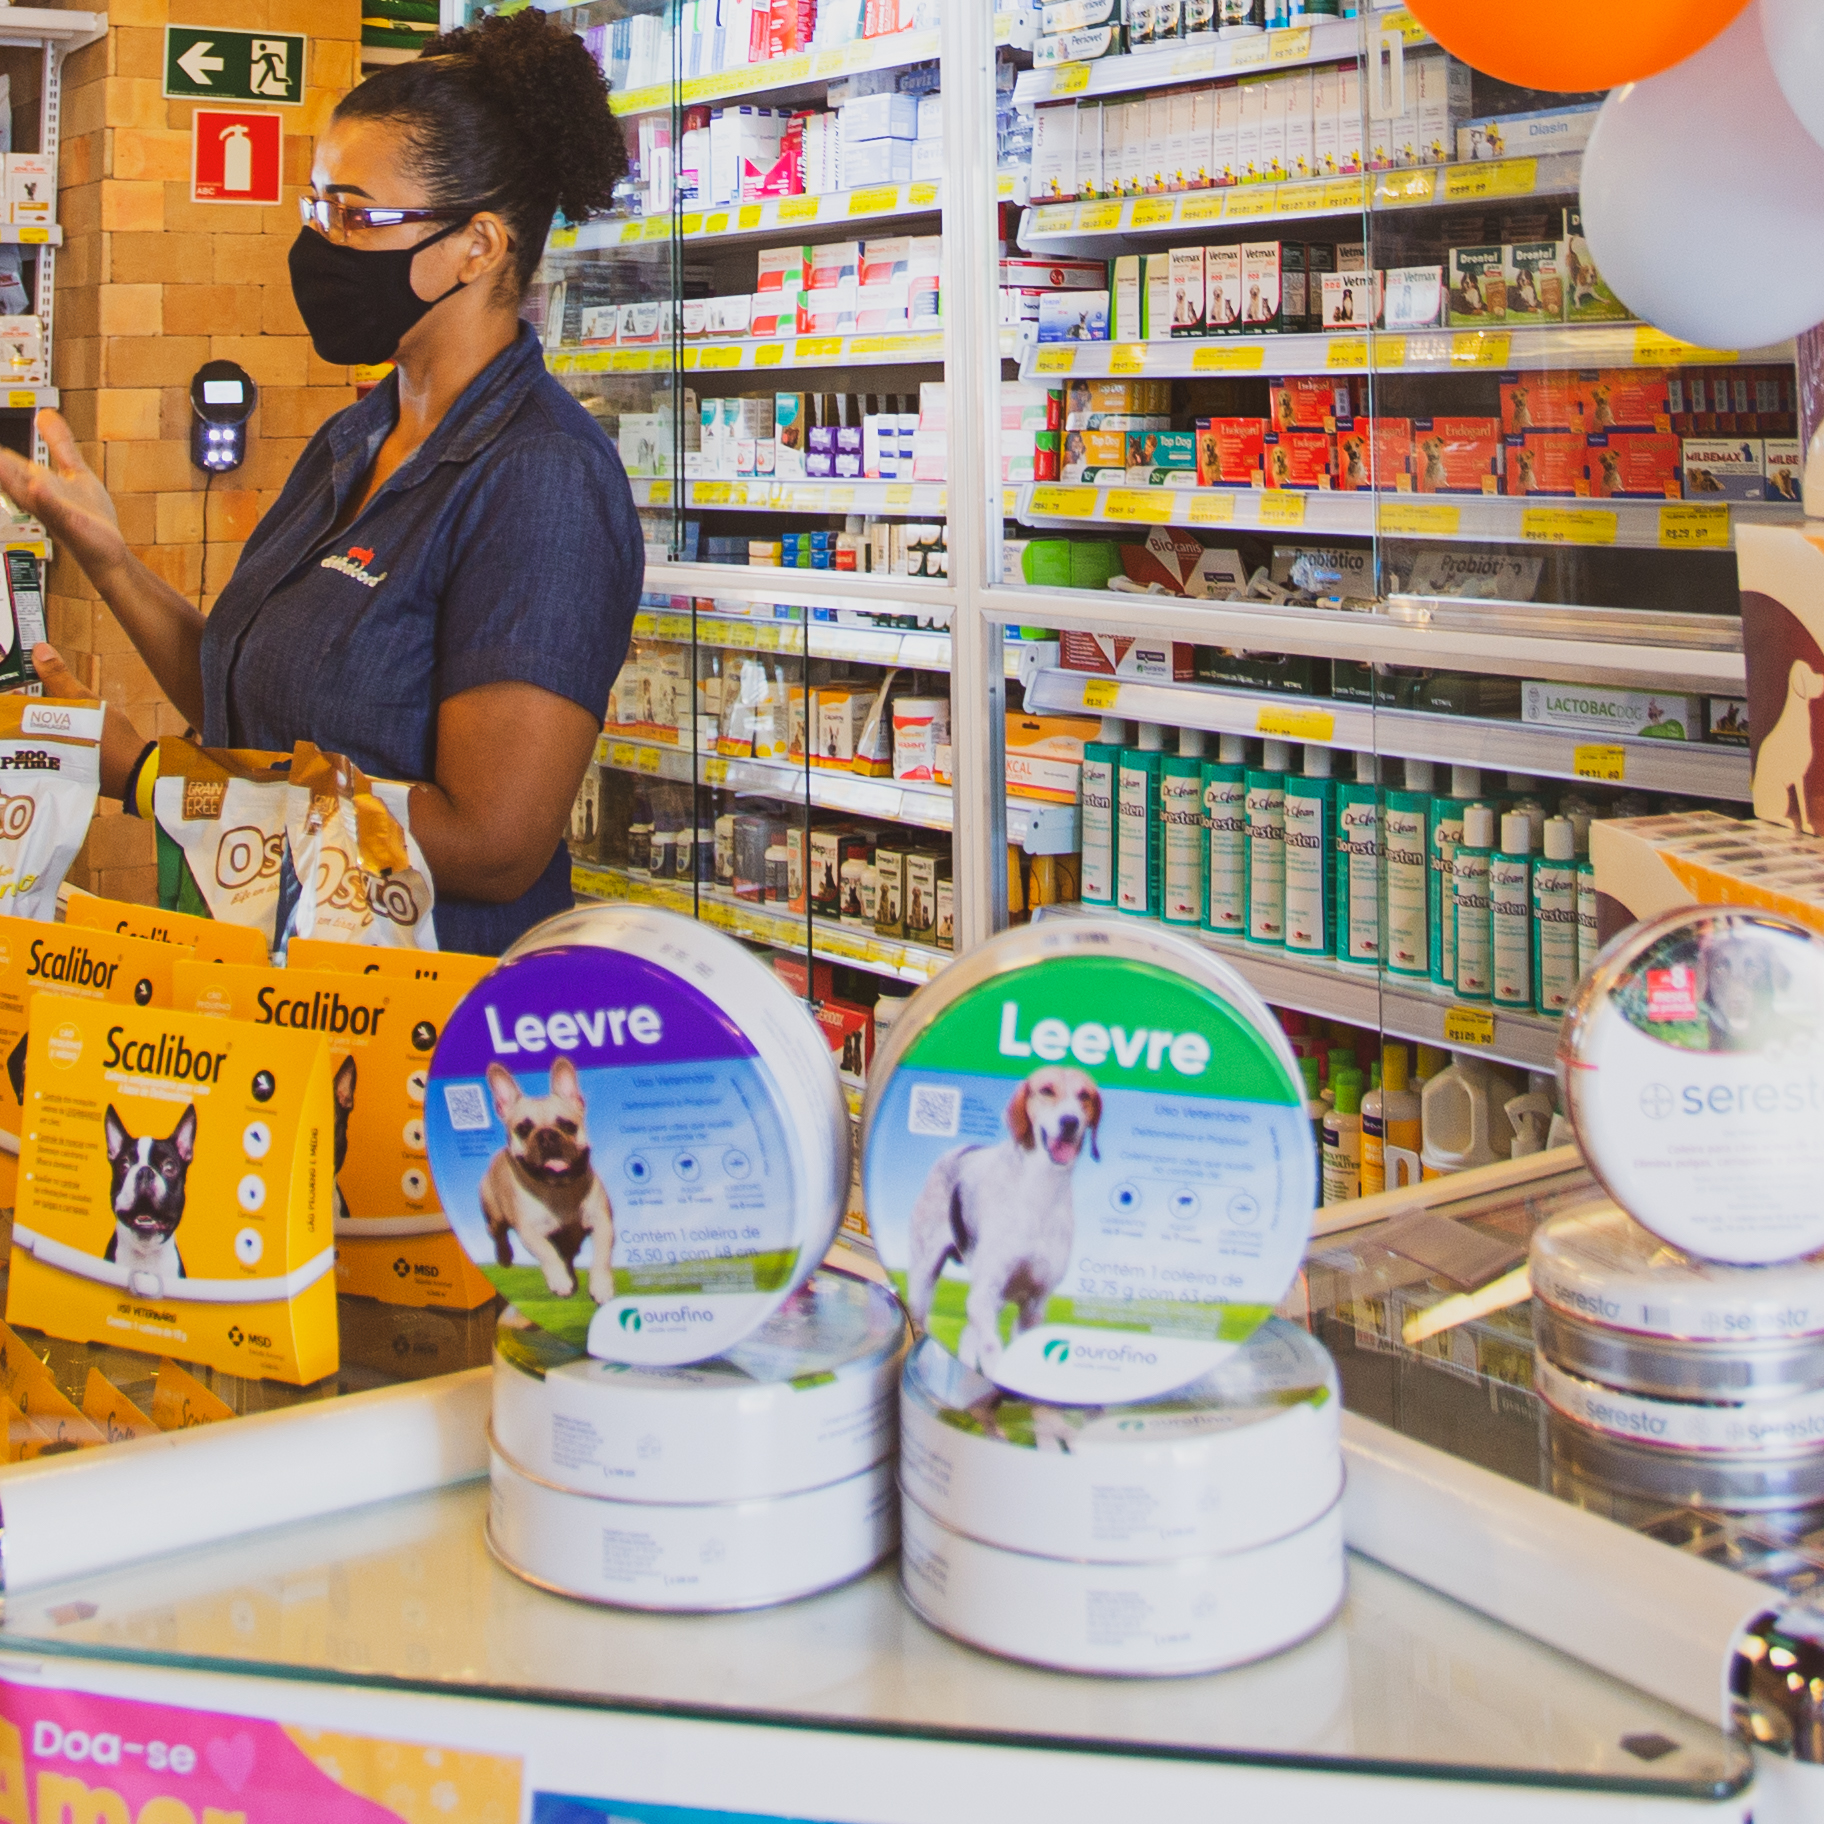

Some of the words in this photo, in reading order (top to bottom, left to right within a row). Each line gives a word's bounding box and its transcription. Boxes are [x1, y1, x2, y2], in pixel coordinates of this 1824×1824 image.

[1529, 121, 1568, 137] Diasin
[196, 187, 215, 195] ABC
[1172, 252, 1201, 263] Vetmax
[1208, 250, 1238, 261] Vetmax
[1245, 248, 1276, 259] Vetmax
[1459, 252, 1499, 264] Drontal
[1515, 248, 1553, 262] Drontal
[1445, 422, 1497, 440] Endogard
[1091, 435, 1105, 448] Top
[1106, 436, 1120, 449] Dog
[1160, 435, 1174, 449] Top
[1175, 436, 1192, 451] Dog
[1686, 450, 1742, 464] MILBEMAX
[1768, 453, 1799, 466] MILBE
[1151, 536, 1205, 556] Biocanis
[30, 711, 72, 726] NOVA
[185, 794, 219, 816] FREE
[26, 939, 119, 989] Scalibor
[255, 986, 385, 1036] Scalibor
[485, 1004, 664, 1054] Leevre
[998, 999, 1212, 1075] Leevre
[103, 1026, 227, 1083] Scalibor
[620, 1227, 676, 1244] Contém
[690, 1226, 738, 1243] coleira
[742, 1226, 760, 1240] de
[679, 1248, 712, 1260] com
[1079, 1258, 1146, 1278] Contém
[1161, 1266, 1217, 1287] coleira
[1222, 1273, 1244, 1288] de
[1139, 1285, 1174, 1302] com
[644, 1305, 714, 1325] ourofino
[248, 1333, 272, 1348] MSD
[1075, 1343, 1157, 1365] ourofino
[1585, 1396, 1667, 1434] seresto
[33, 1720, 197, 1774] Doa-se
